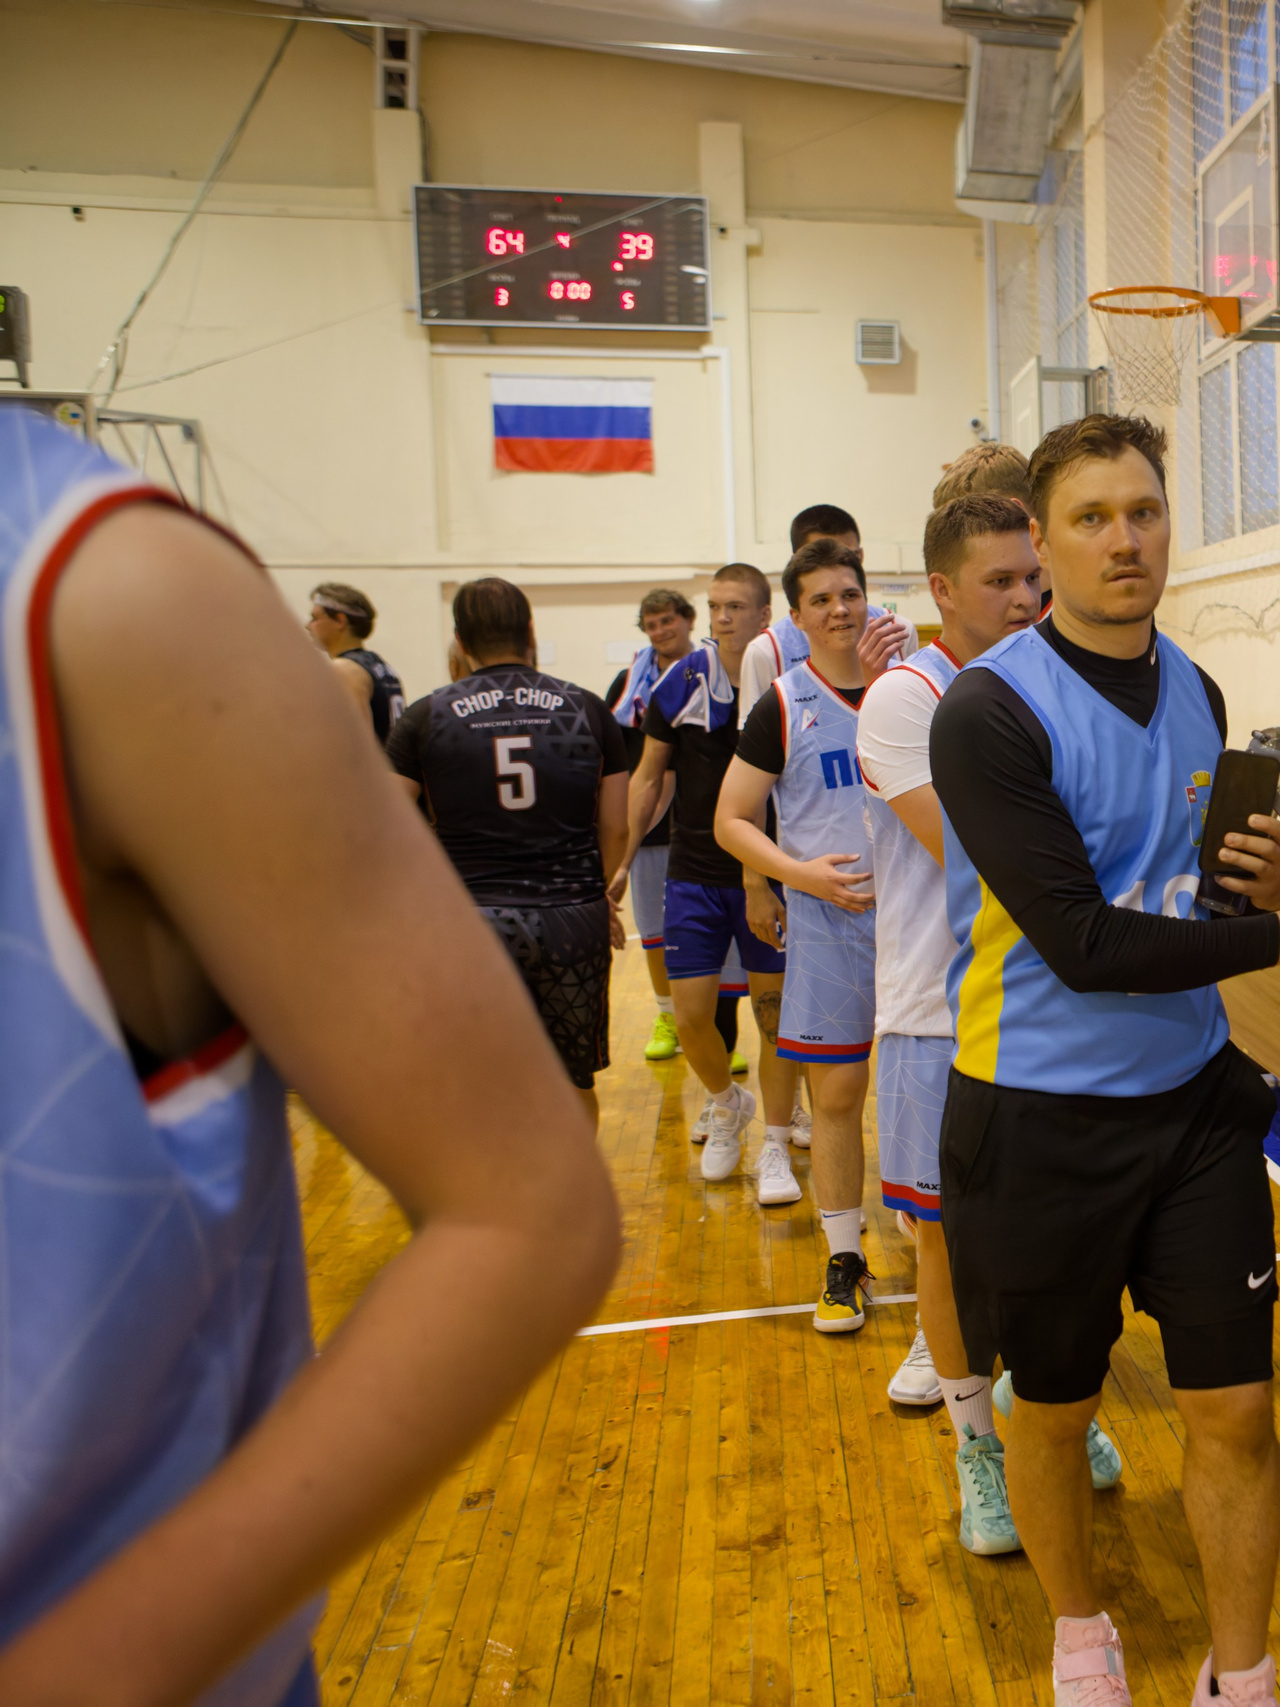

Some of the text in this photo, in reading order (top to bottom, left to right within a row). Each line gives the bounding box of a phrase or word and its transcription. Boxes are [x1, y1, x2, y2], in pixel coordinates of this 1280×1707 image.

[486, 227, 525, 256] 64
[619, 231, 654, 261] 39
[494, 286, 510, 307] 3
[452, 687, 564, 718] CHOP-CHOP
[795, 694, 818, 703] MAXX
[494, 735, 537, 811] 5
[820, 749, 863, 789] П
